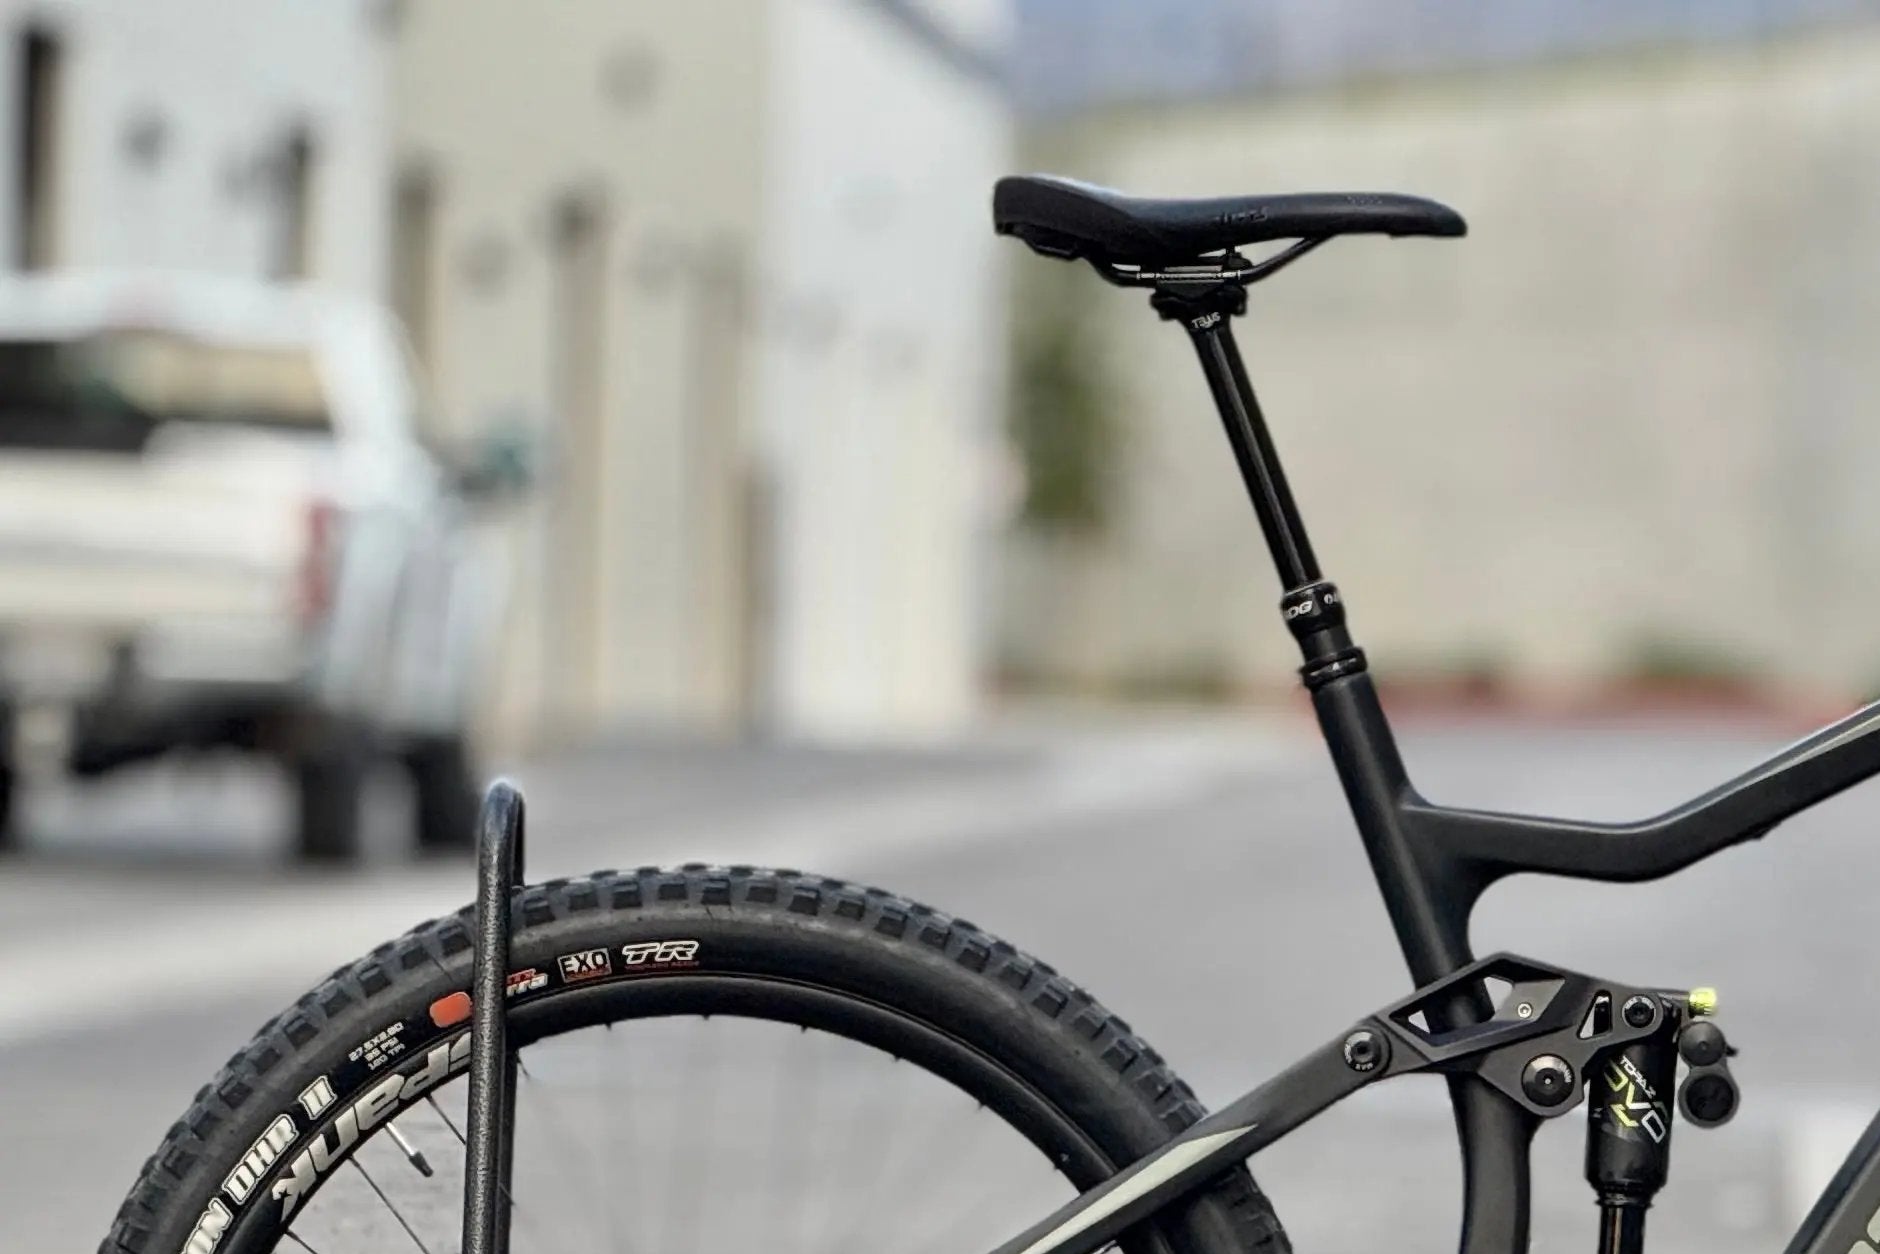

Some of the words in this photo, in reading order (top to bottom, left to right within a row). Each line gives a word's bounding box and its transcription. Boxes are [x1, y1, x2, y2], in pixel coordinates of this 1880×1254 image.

[559, 951, 609, 978] EXO
[622, 941, 699, 965] TR
[222, 1114, 299, 1205] DHR
